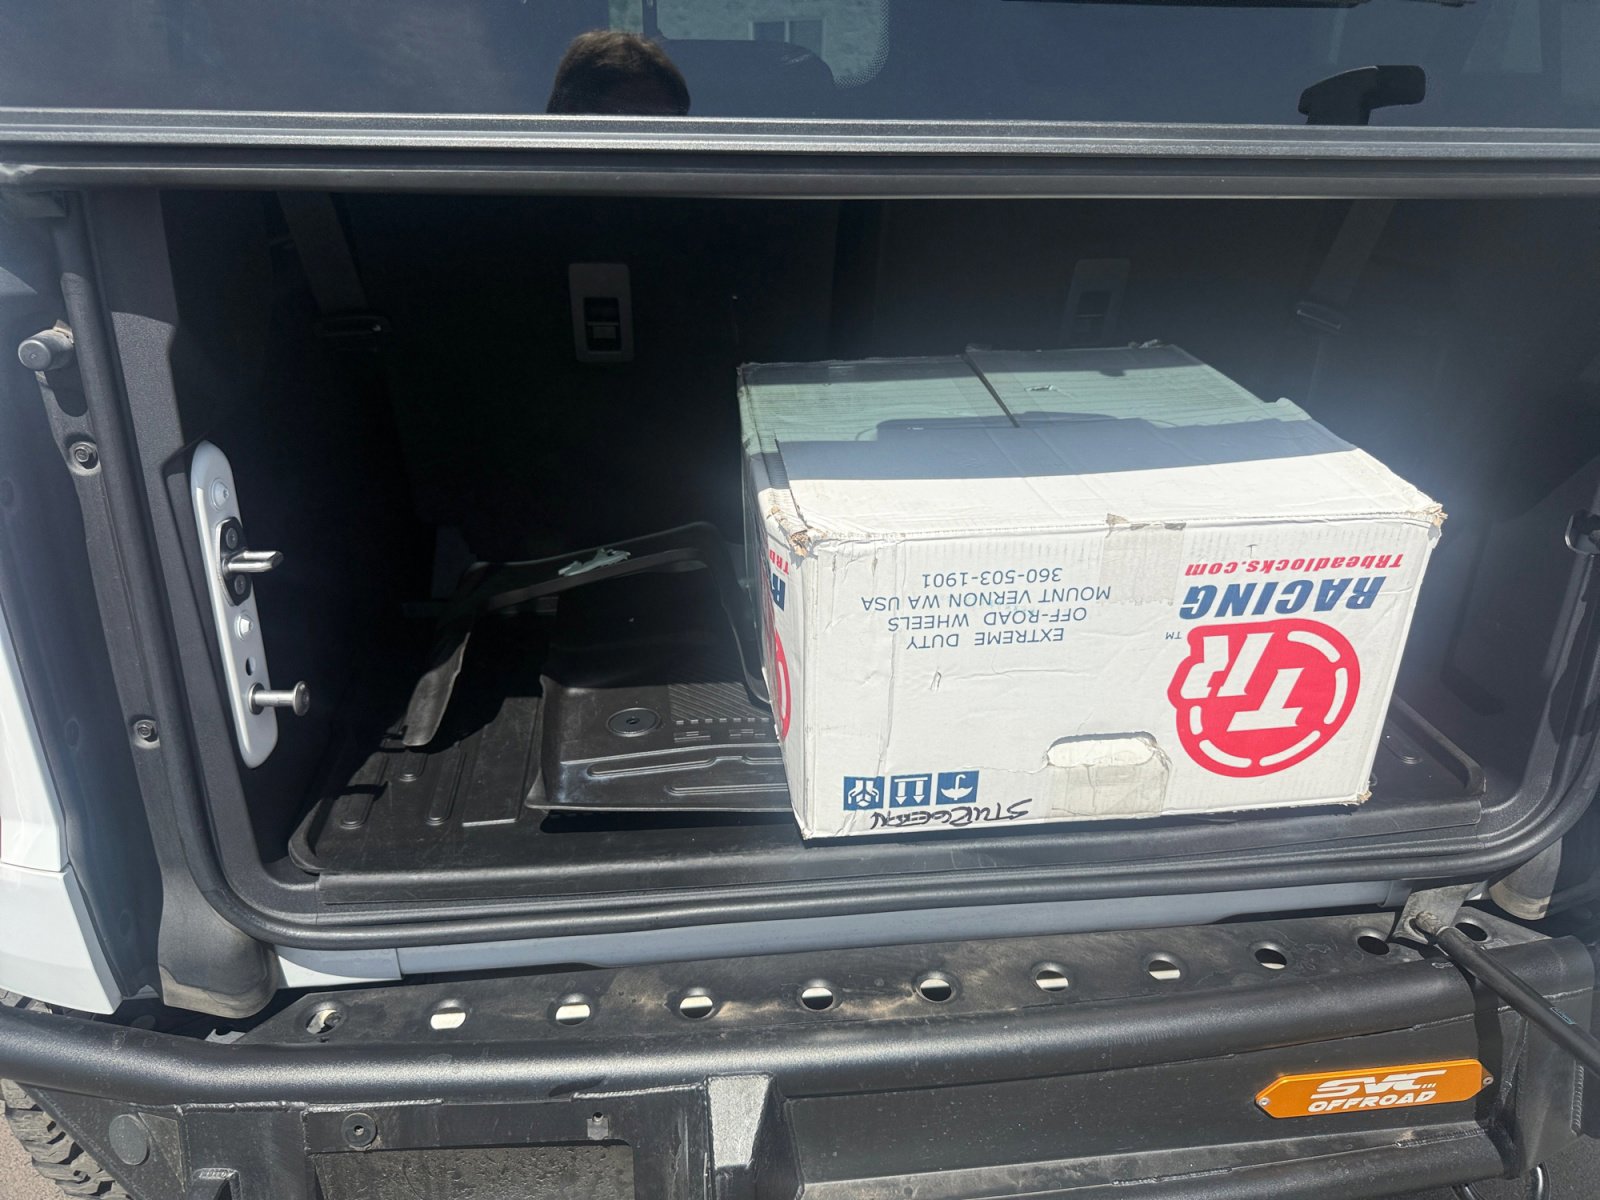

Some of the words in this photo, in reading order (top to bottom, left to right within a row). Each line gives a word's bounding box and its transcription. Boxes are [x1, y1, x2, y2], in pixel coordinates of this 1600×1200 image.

[1185, 554, 1403, 576] TRbeadlocks.com
[922, 567, 1063, 588] 360-503-1901
[861, 596, 900, 611] USA
[908, 595, 940, 609] WA
[949, 589, 1031, 607] VERNON
[1038, 586, 1111, 603] MOUNT
[1179, 576, 1386, 620] RACING
[888, 613, 970, 632] WHEELS
[983, 607, 1087, 626] OFF-ROAD
[906, 633, 959, 650] DUTY
[974, 627, 1064, 646] EXTREME
[1180, 632, 1305, 733] TR
[1310, 1069, 1447, 1099] SVC
[1307, 1090, 1437, 1113] OFFROAD
